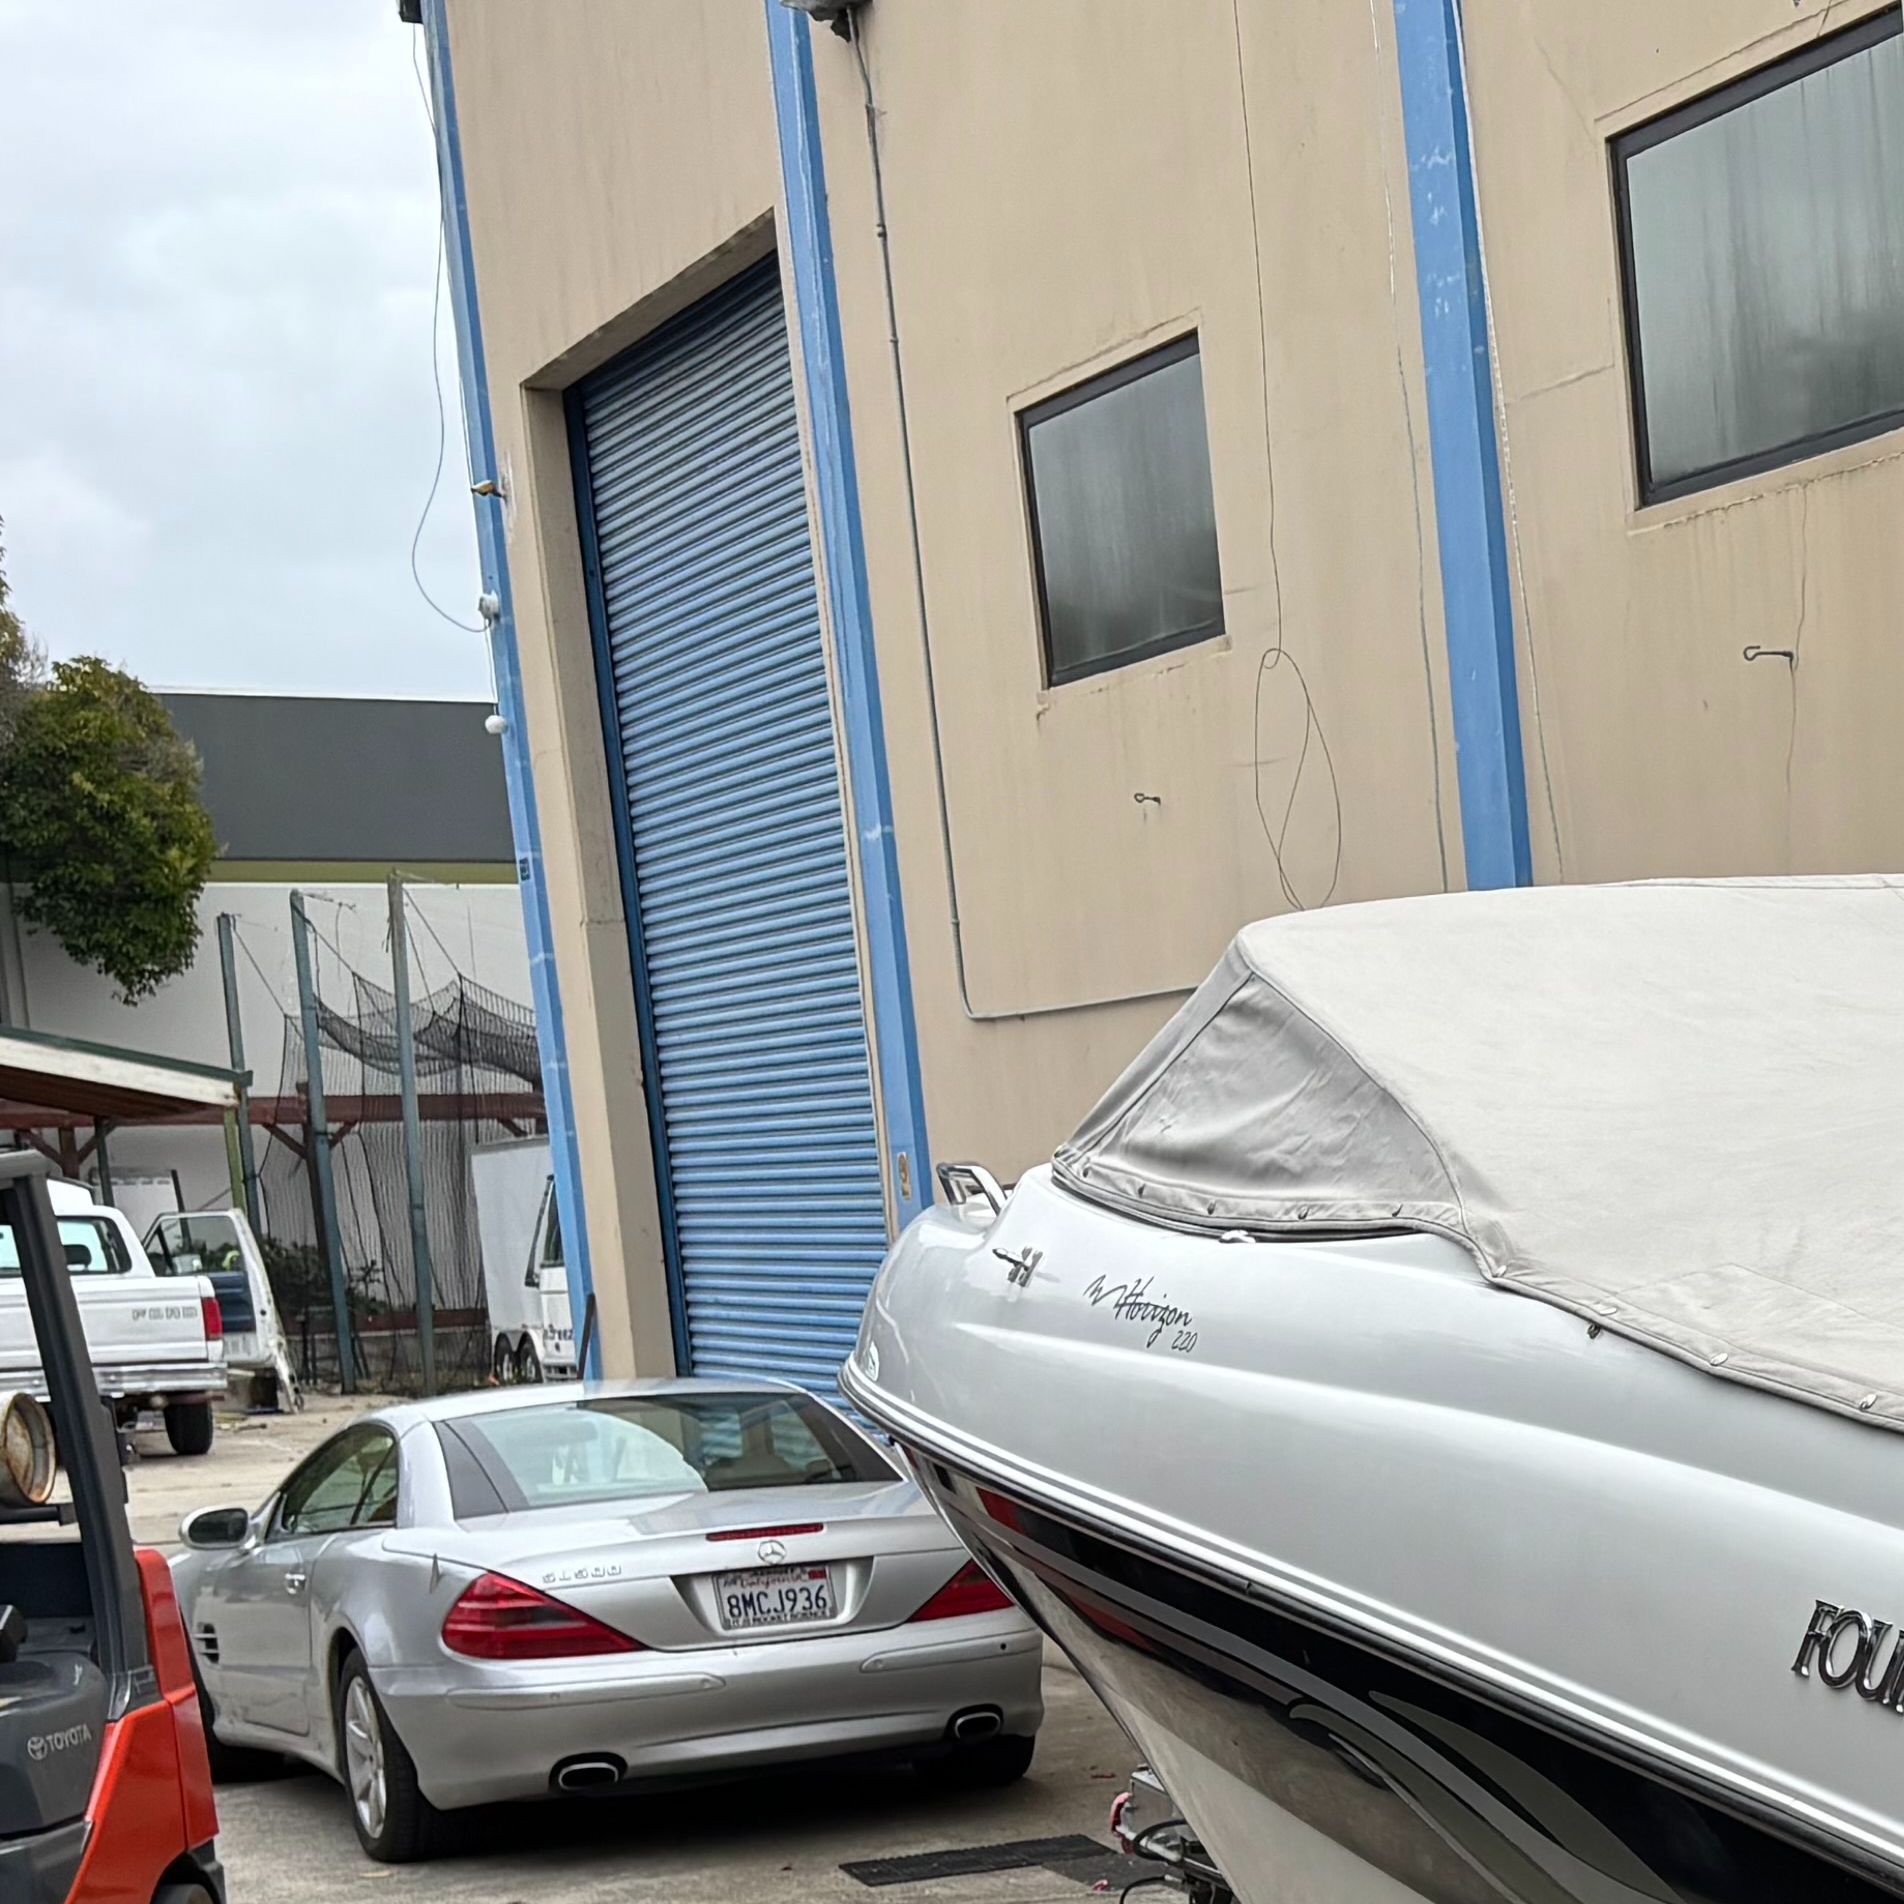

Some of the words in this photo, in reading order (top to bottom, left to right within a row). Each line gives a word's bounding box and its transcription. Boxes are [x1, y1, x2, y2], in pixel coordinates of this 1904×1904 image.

[1113, 1276, 1193, 1349] Horizon
[1171, 1330, 1198, 1353] 220
[727, 1585, 828, 1618] 8MCJ936
[45, 1723, 92, 1752] TOYOTA
